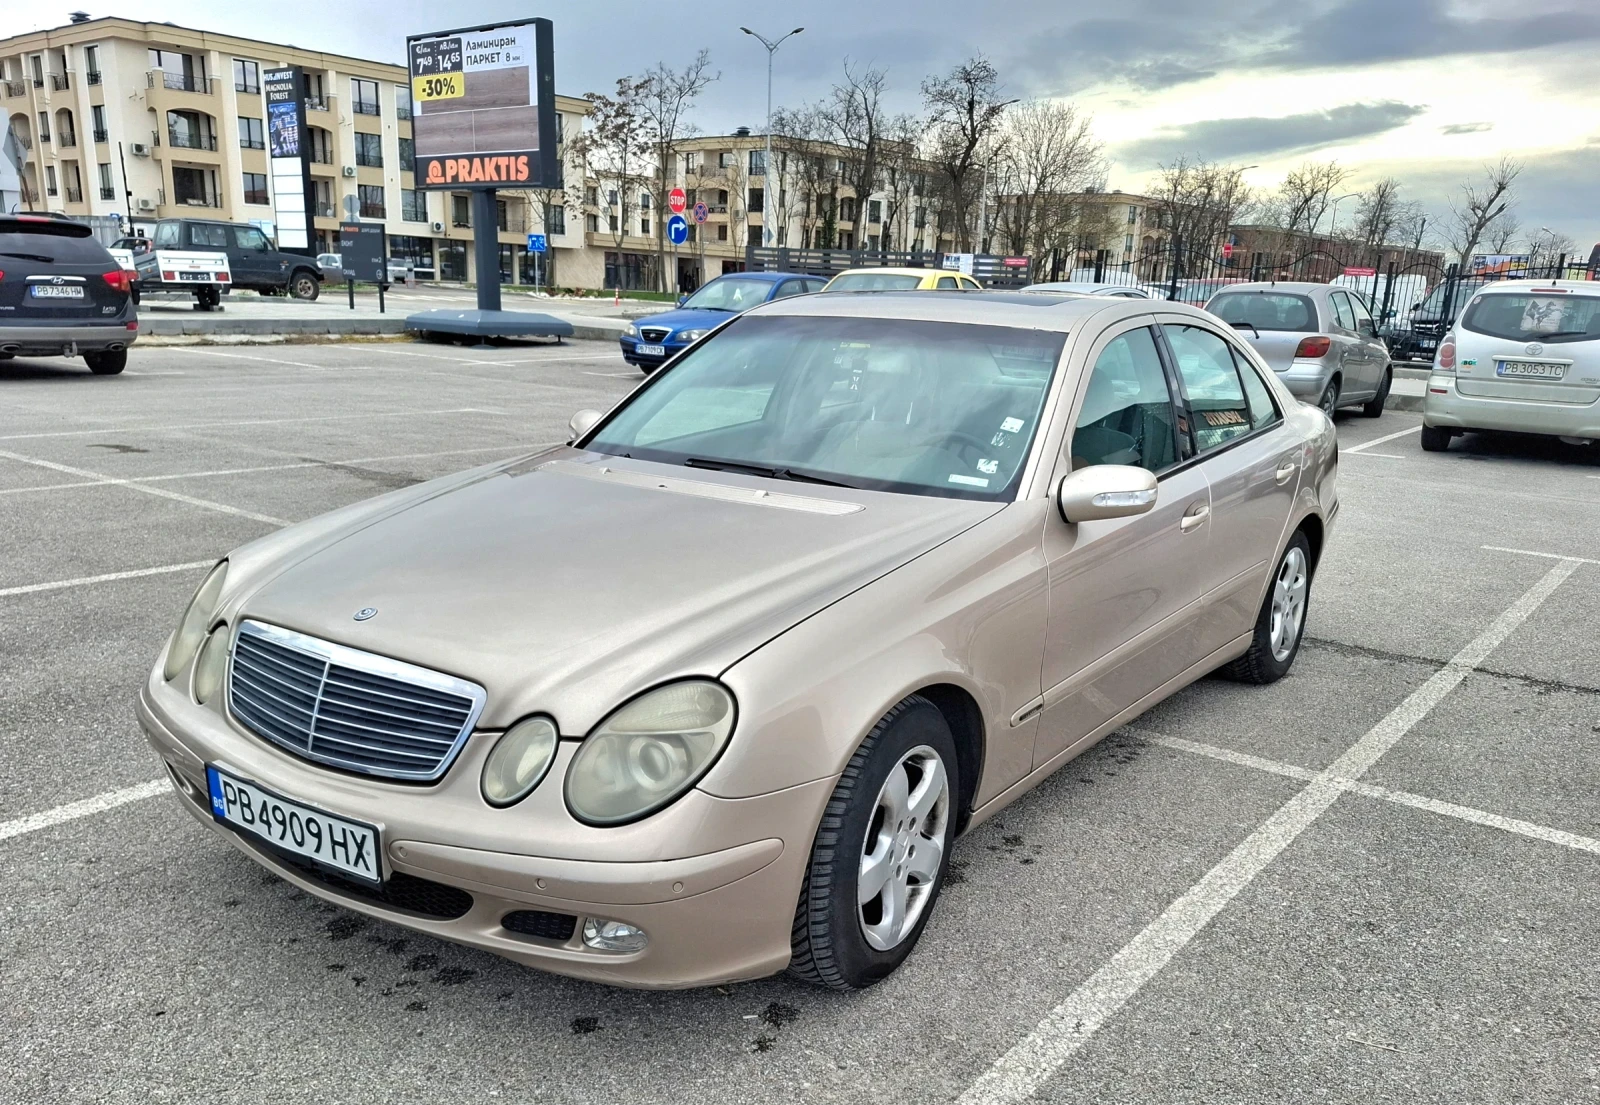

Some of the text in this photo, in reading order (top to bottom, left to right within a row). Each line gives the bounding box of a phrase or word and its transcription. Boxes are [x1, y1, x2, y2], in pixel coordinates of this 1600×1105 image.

[465, 37, 516, 51] Ламиниран
[466, 52, 501, 66] ПАРКЕТ
[505, 52, 511, 62] 8
[265, 83, 293, 92] MAGNOLIA
[421, 77, 456, 97] -30%
[270, 92, 288, 100] FOREST
[445, 155, 529, 183] PRAKTIS
[670, 195, 685, 206] STOP
[50, 286, 69, 296] 7346
[1504, 363, 1518, 373] PB
[1520, 364, 1545, 374] 3053
[213, 779, 371, 872] BG PB 4909 HX
